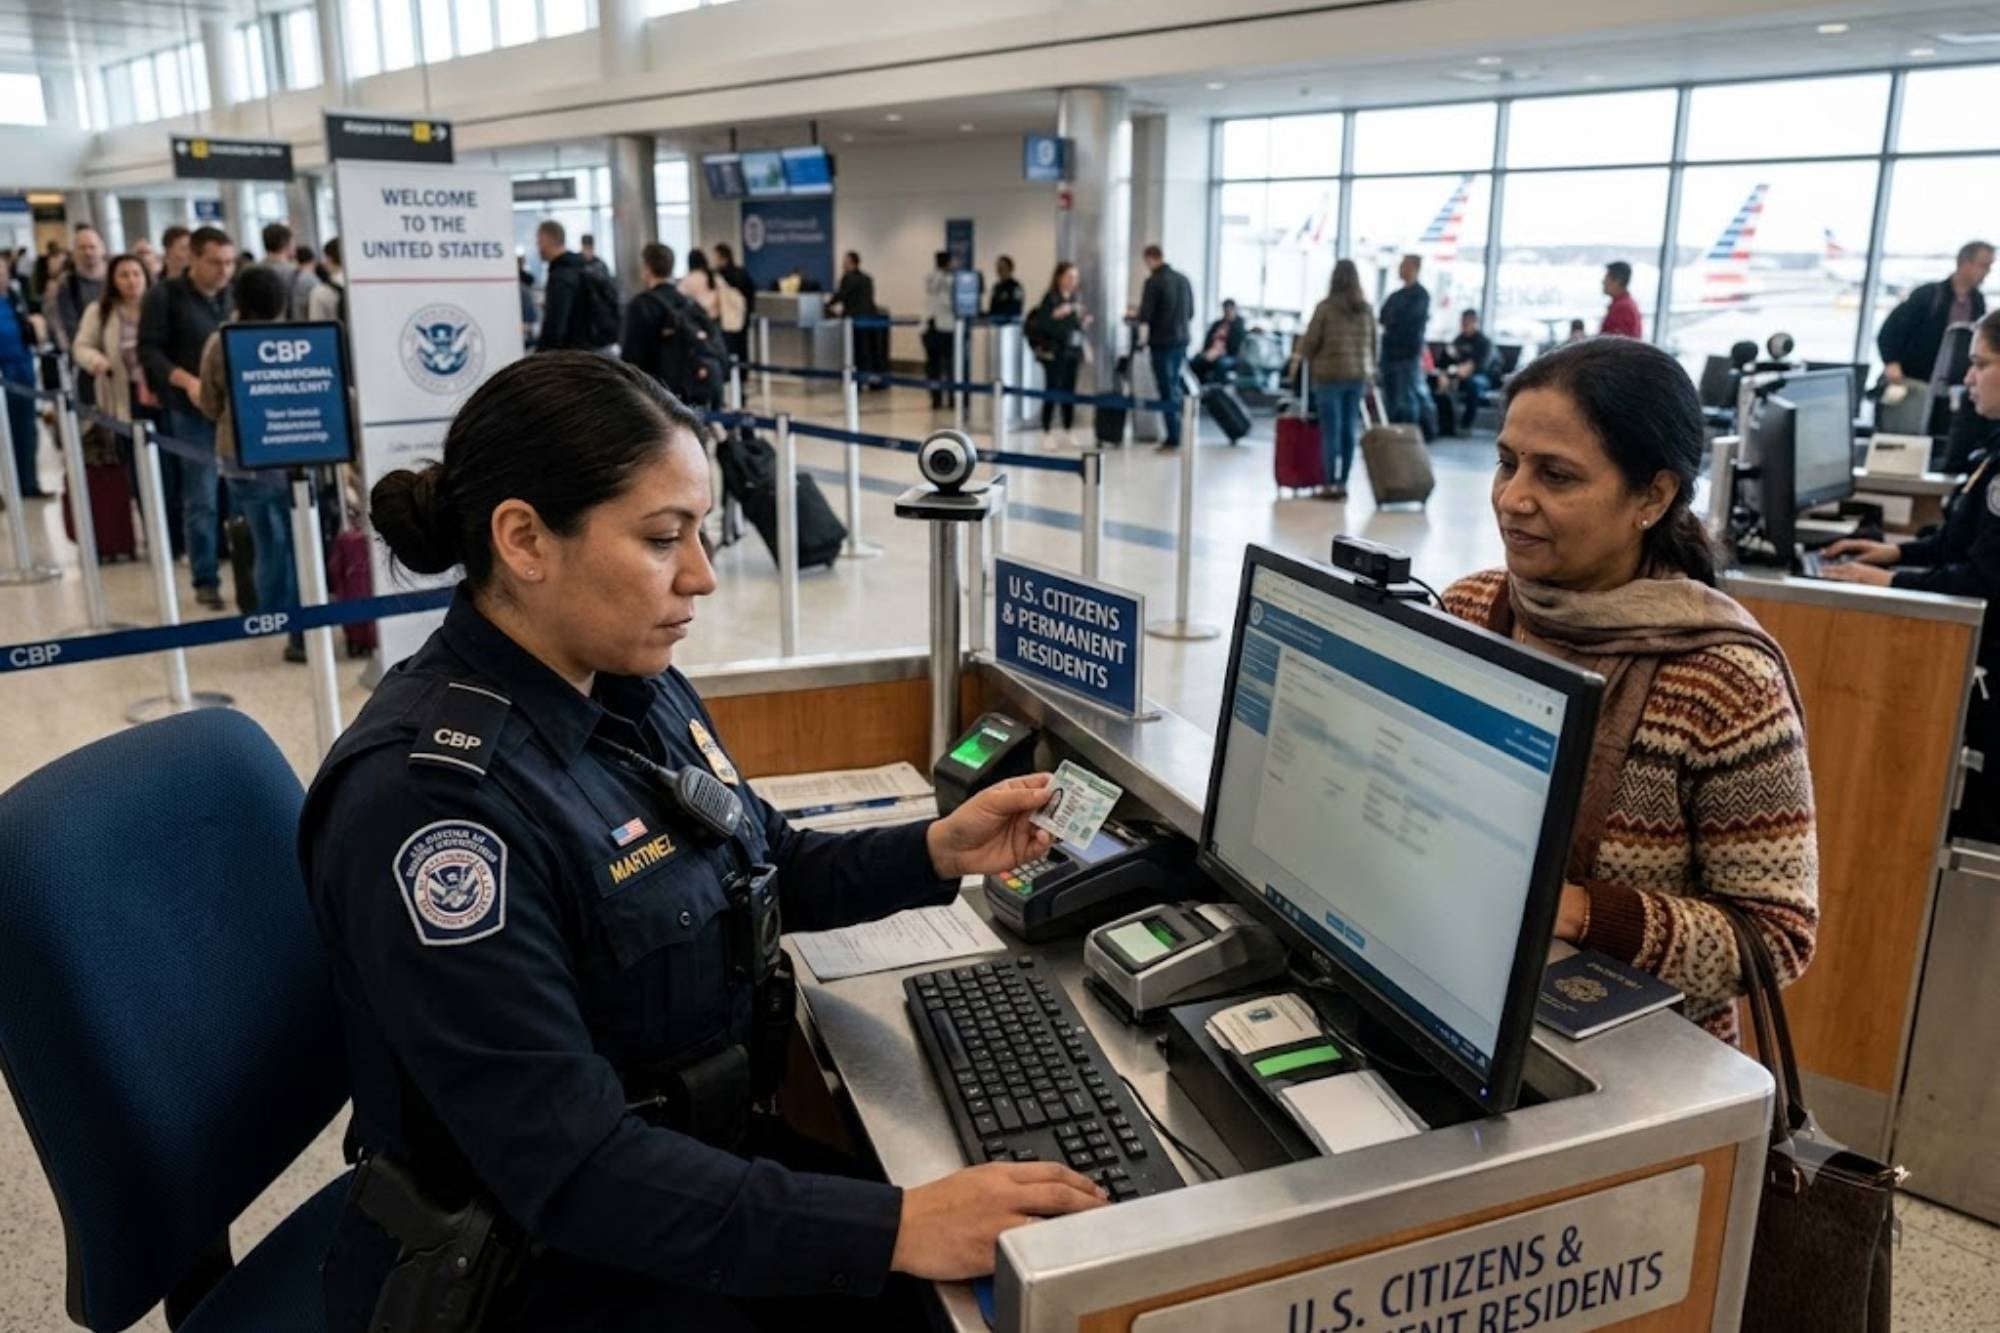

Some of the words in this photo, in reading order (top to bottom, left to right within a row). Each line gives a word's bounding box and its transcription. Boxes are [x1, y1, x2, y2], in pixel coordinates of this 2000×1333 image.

[381, 187, 478, 208] WELCOME
[401, 215, 425, 233] TO
[430, 215, 467, 233] THE
[362, 241, 434, 259] UNITED
[438, 242, 504, 259] STATES
[257, 339, 312, 363] CBP
[1008, 575, 1039, 605] U.S.
[1043, 587, 1121, 632] CITIZENS
[242, 612, 290, 635] CBP
[1002, 602, 1015, 625] &
[1018, 608, 1127, 665] PERMANENT
[9, 643, 62, 667] CBP
[1016, 636, 1109, 689] RESIDENTS
[434, 728, 482, 750] CBP
[1288, 1288, 1366, 1333] U.S.
[1380, 1234, 1546, 1318] CITIZENS
[1556, 1225, 1584, 1267] &
[1478, 1250, 1664, 1333] RESIDENTS
